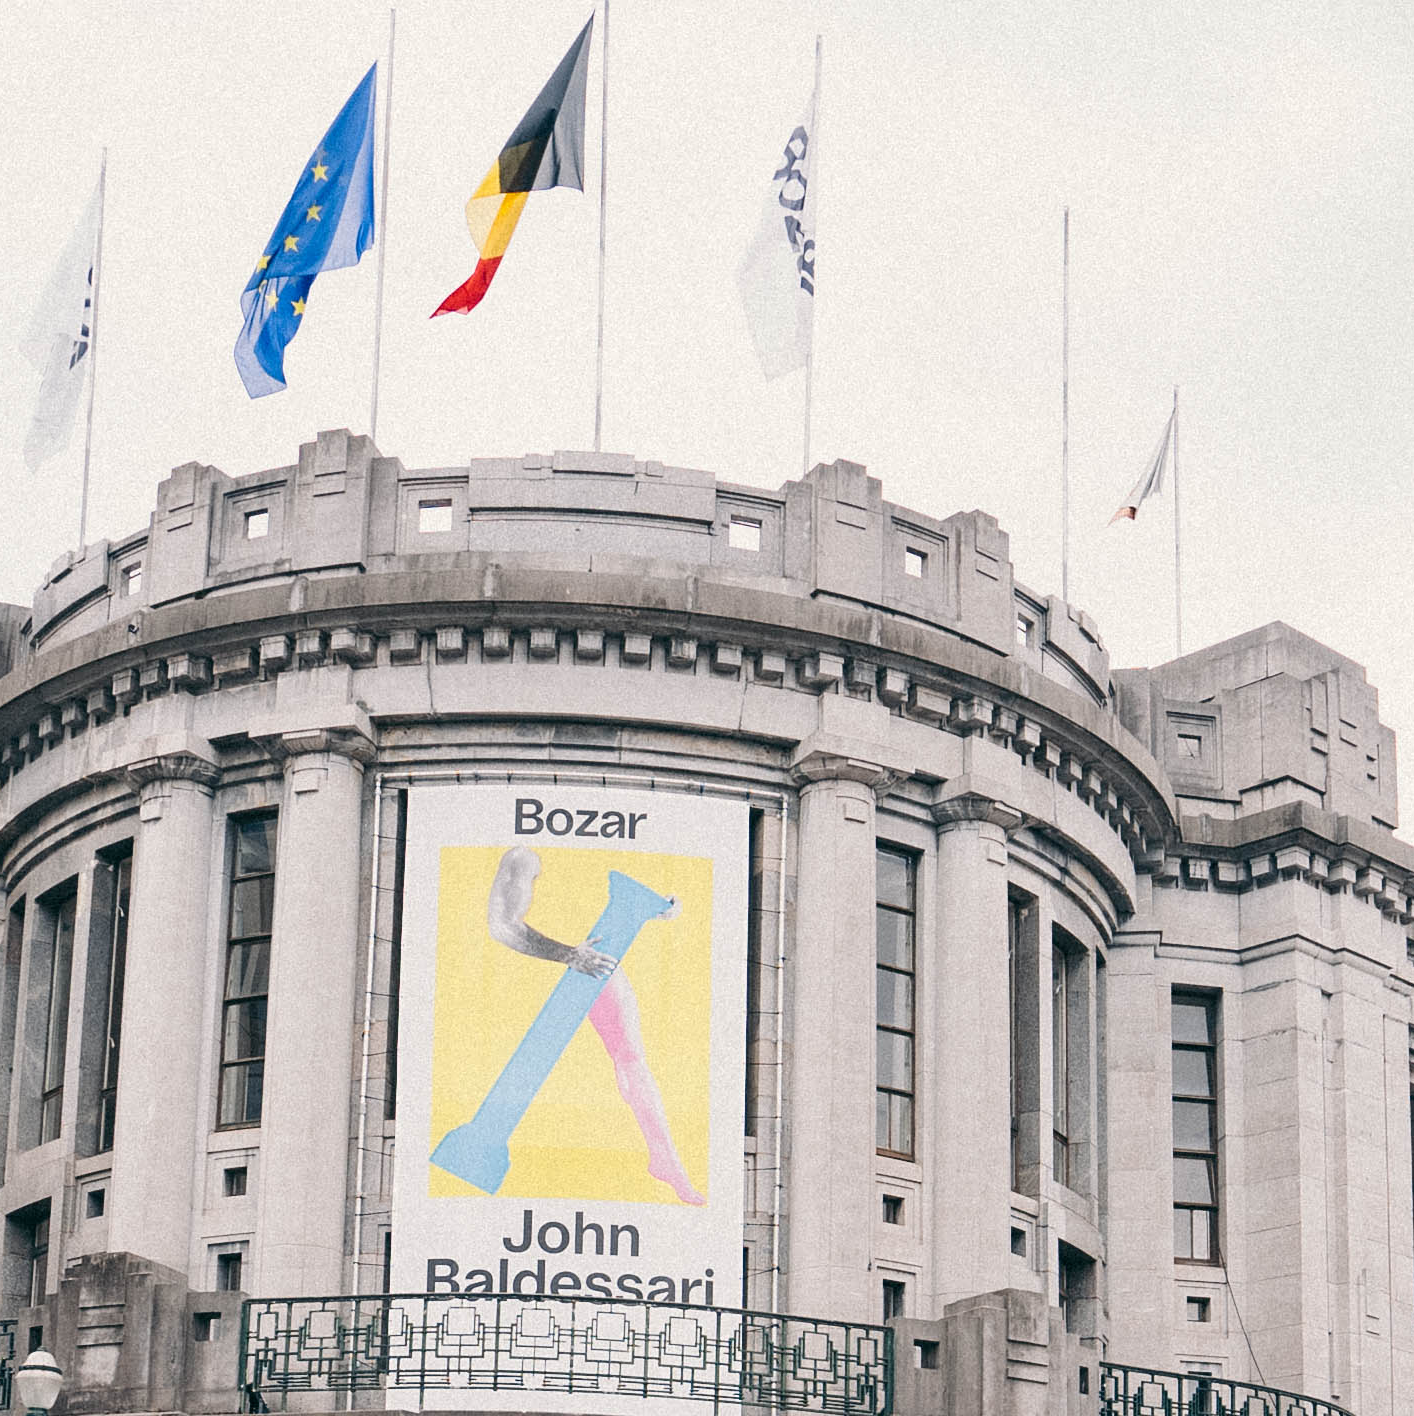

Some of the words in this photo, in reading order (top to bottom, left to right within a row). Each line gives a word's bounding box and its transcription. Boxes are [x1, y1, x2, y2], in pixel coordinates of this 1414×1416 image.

[513, 797, 647, 840] Bozar
[502, 1209, 640, 1257] John
[426, 1258, 714, 1305] Baldessari
